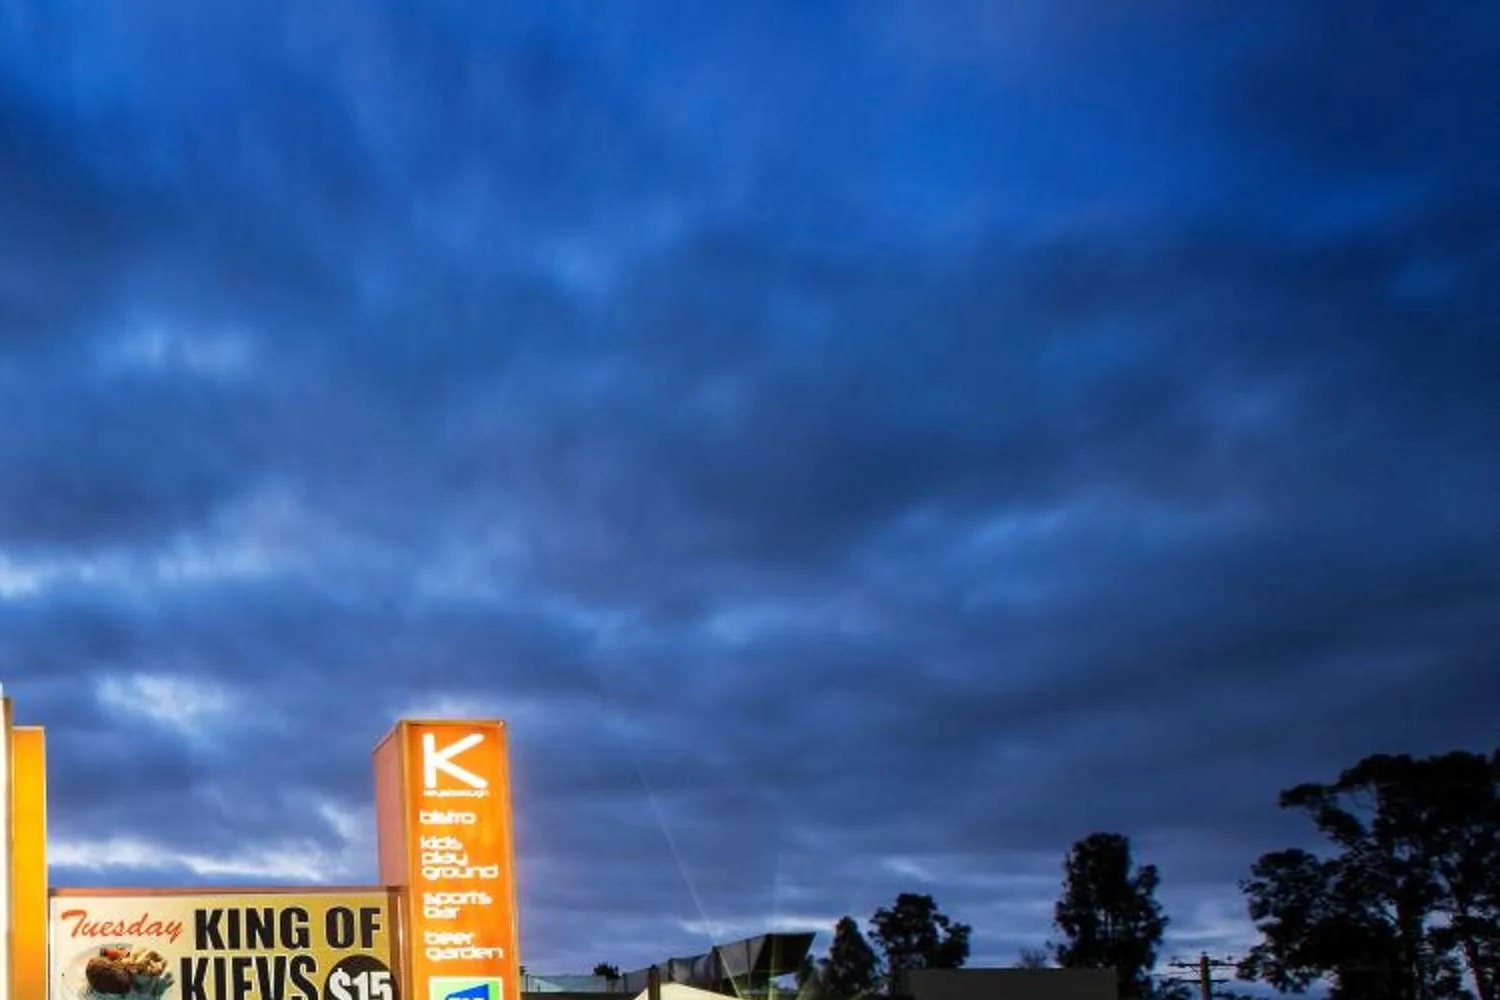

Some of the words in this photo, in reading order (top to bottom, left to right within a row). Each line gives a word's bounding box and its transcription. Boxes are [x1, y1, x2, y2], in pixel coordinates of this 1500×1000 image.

[422, 733, 488, 789] K
[61, 909, 183, 943] Tuesday
[195, 907, 310, 950] KING
[326, 906, 380, 949] OF
